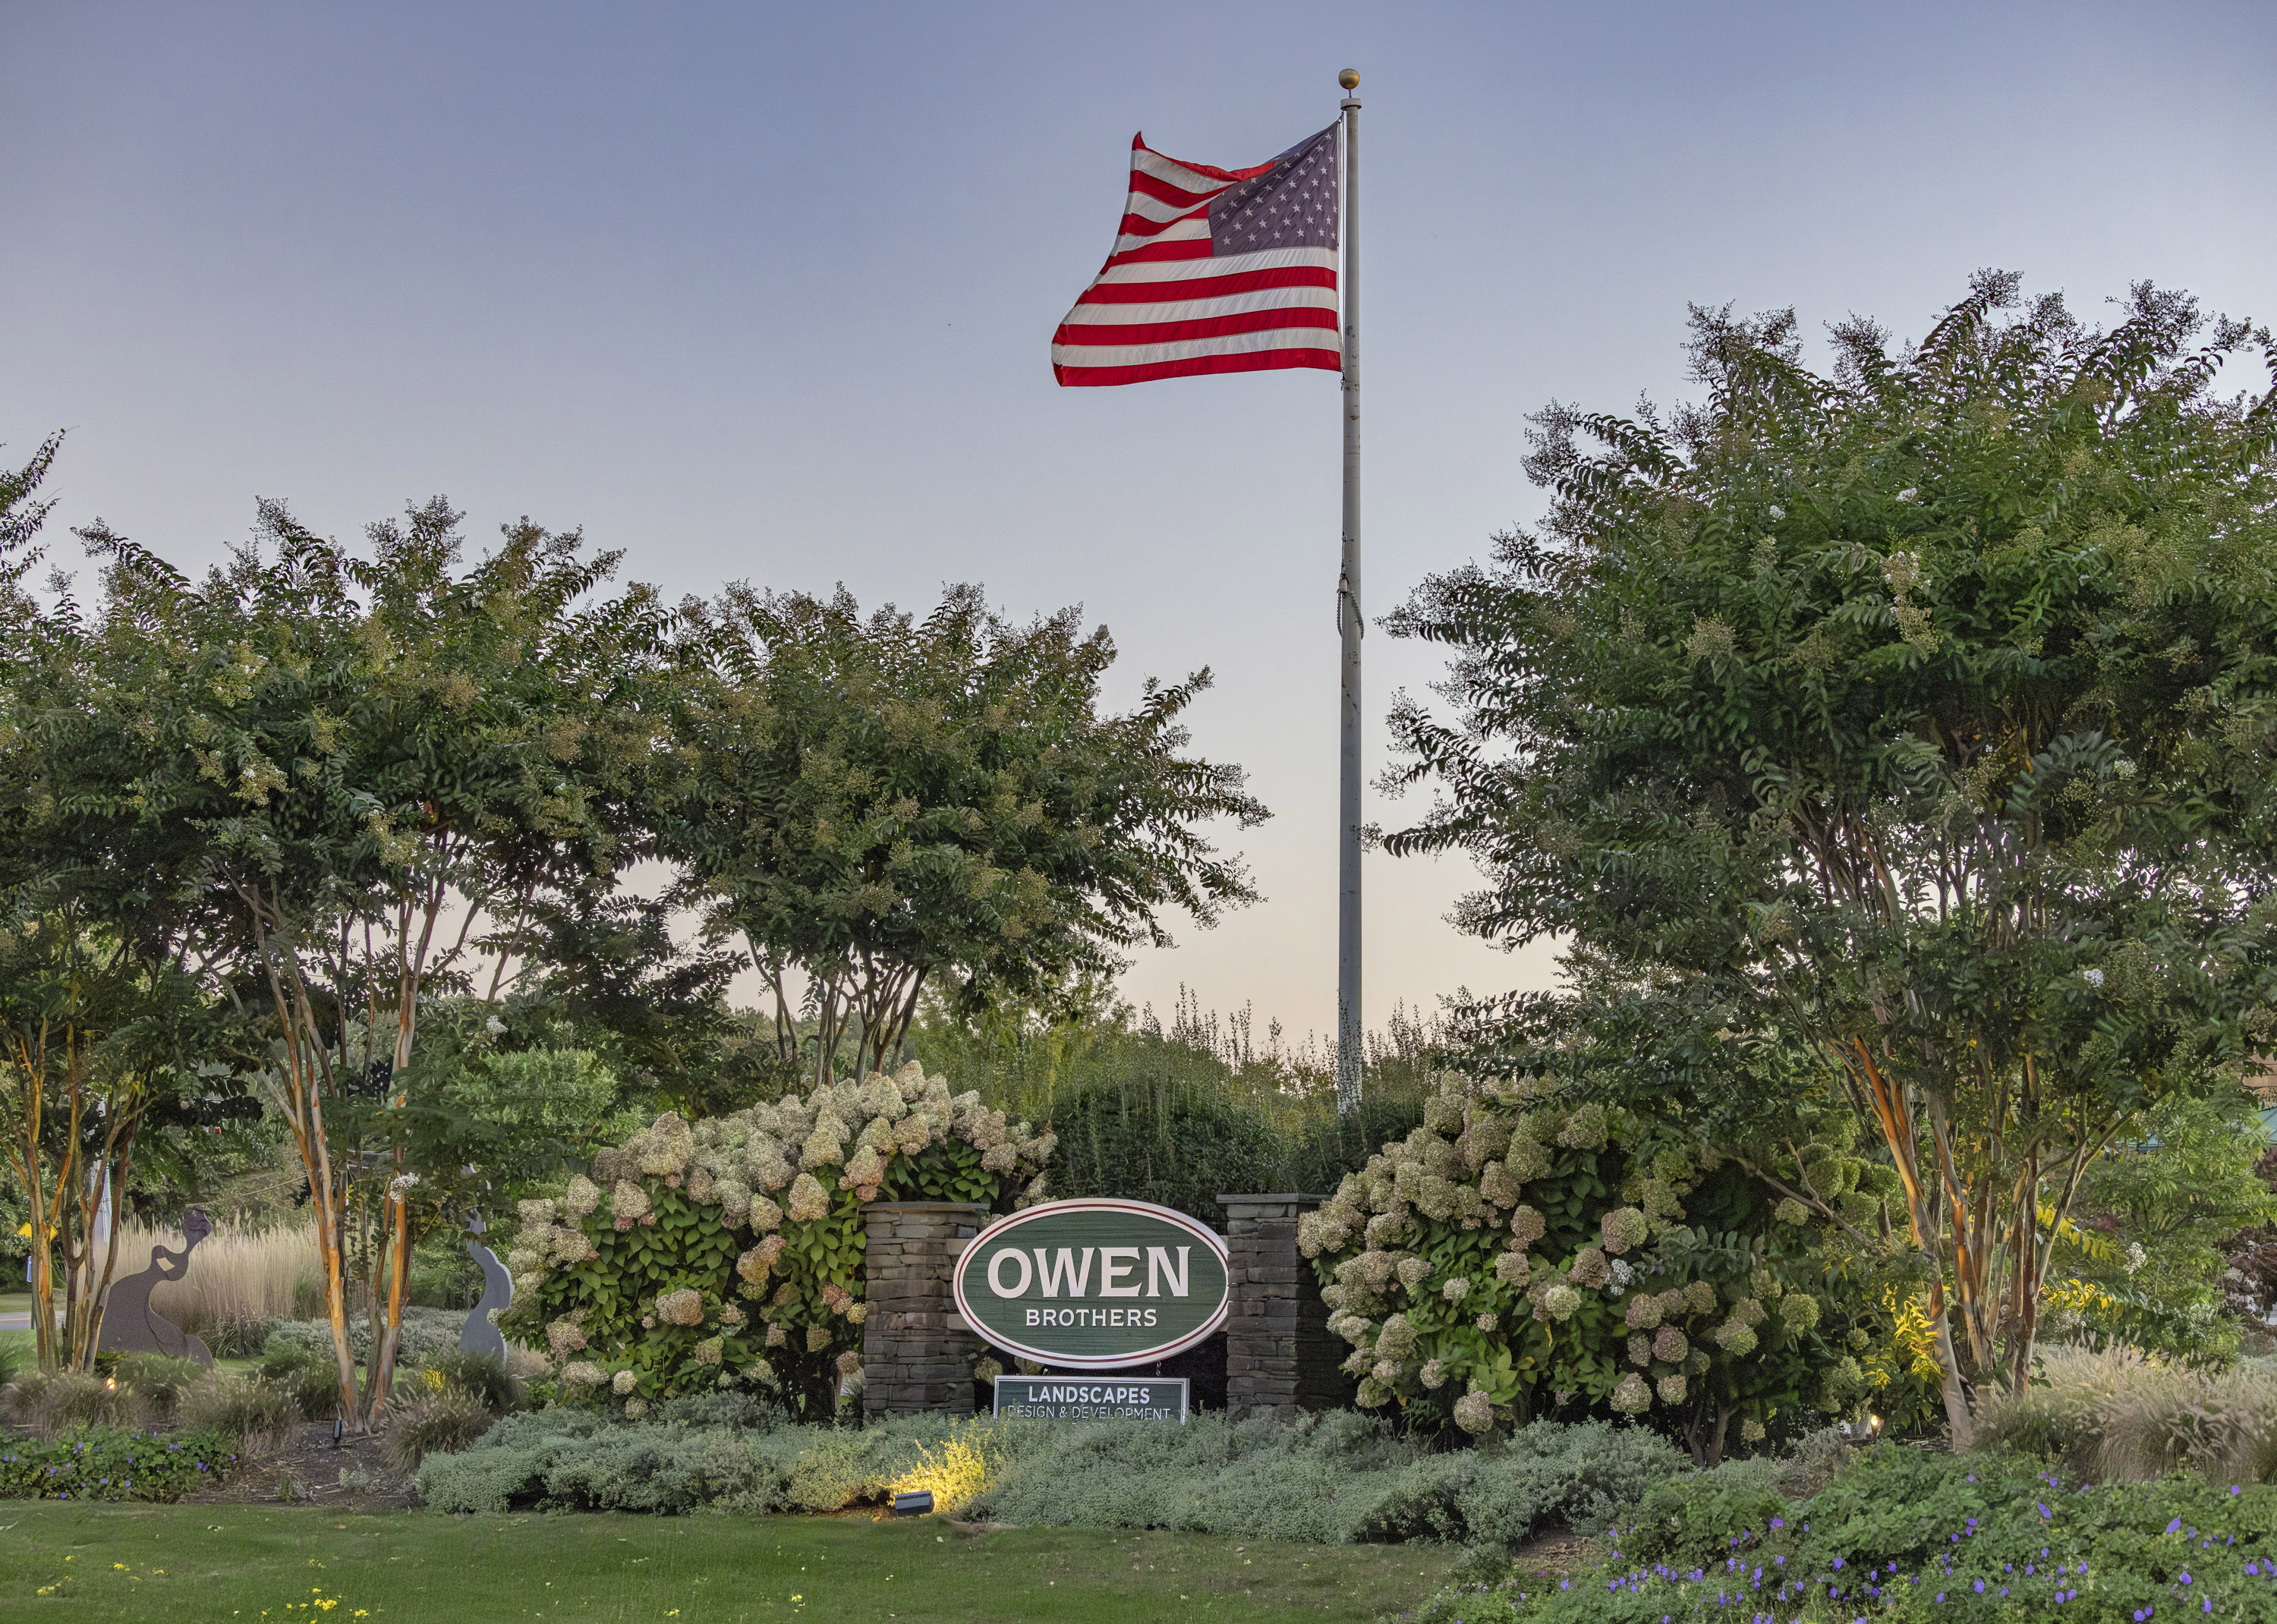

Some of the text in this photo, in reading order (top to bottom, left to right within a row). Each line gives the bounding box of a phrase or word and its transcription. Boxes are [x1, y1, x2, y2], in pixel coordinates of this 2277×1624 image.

[987, 1246, 1192, 1298] OWEN
[1026, 1308, 1157, 1327] BROTHERS
[1028, 1386, 1151, 1404] LANDSCAPES
[1007, 1405, 1171, 1421] DESIGN & DEVELOPMENT
